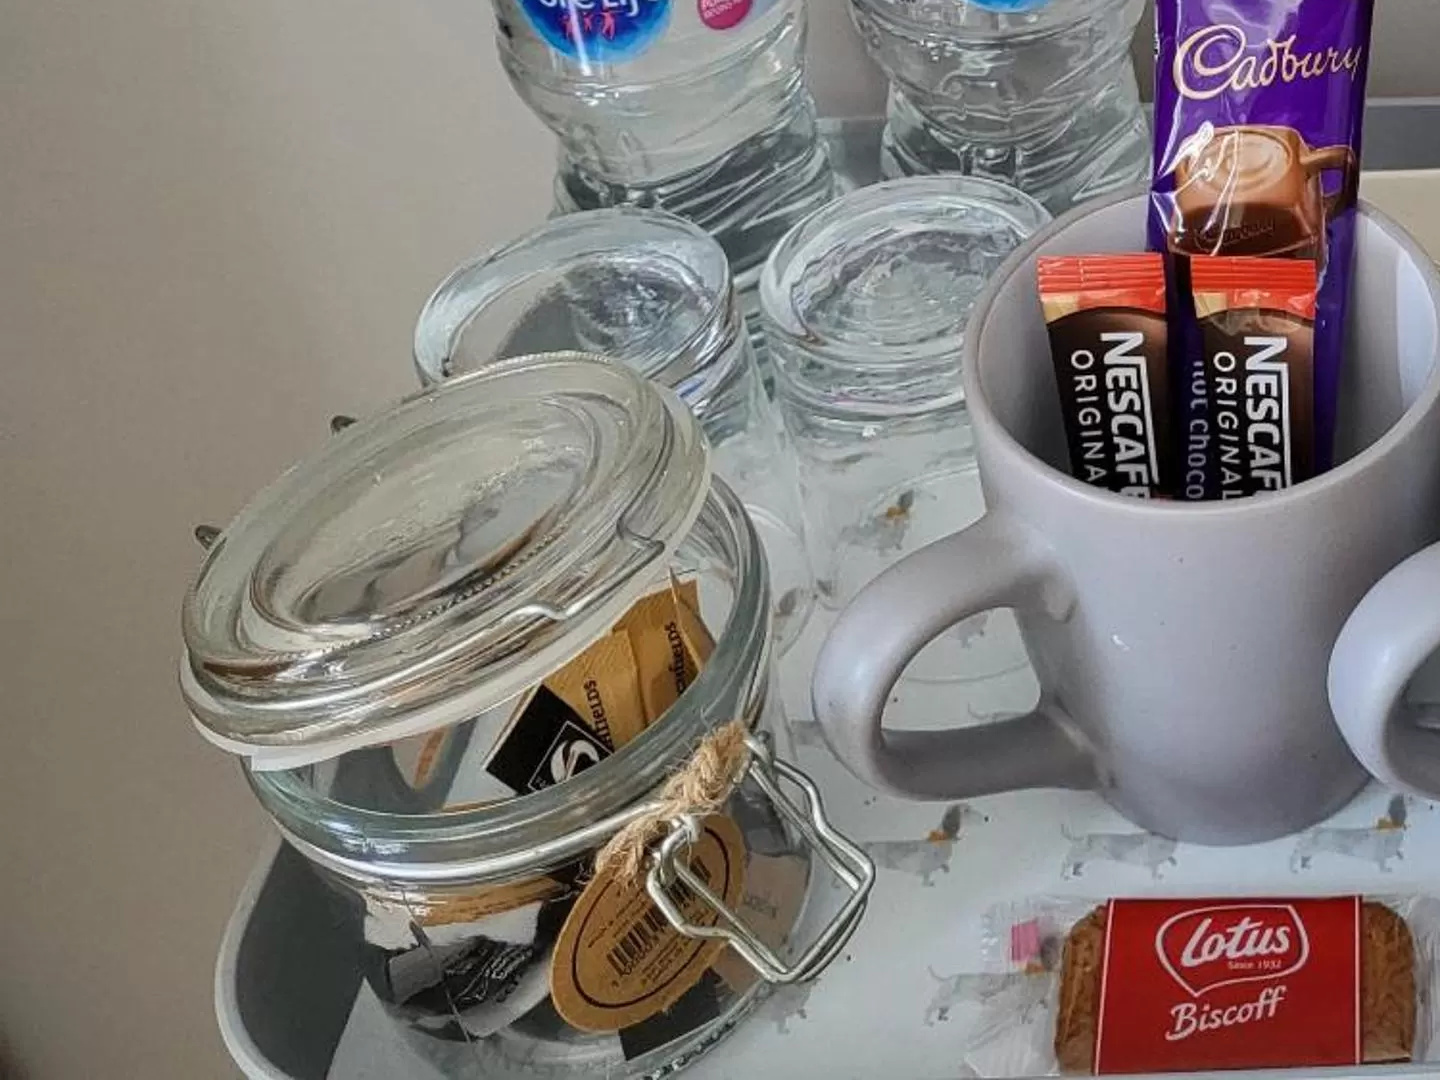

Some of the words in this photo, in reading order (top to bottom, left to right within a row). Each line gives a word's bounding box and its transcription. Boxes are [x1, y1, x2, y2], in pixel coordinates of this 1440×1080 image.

[1173, 23, 1362, 100] Cadbury
[1180, 916, 1291, 968] Lotus
[1165, 985, 1287, 1042] Biscoff
